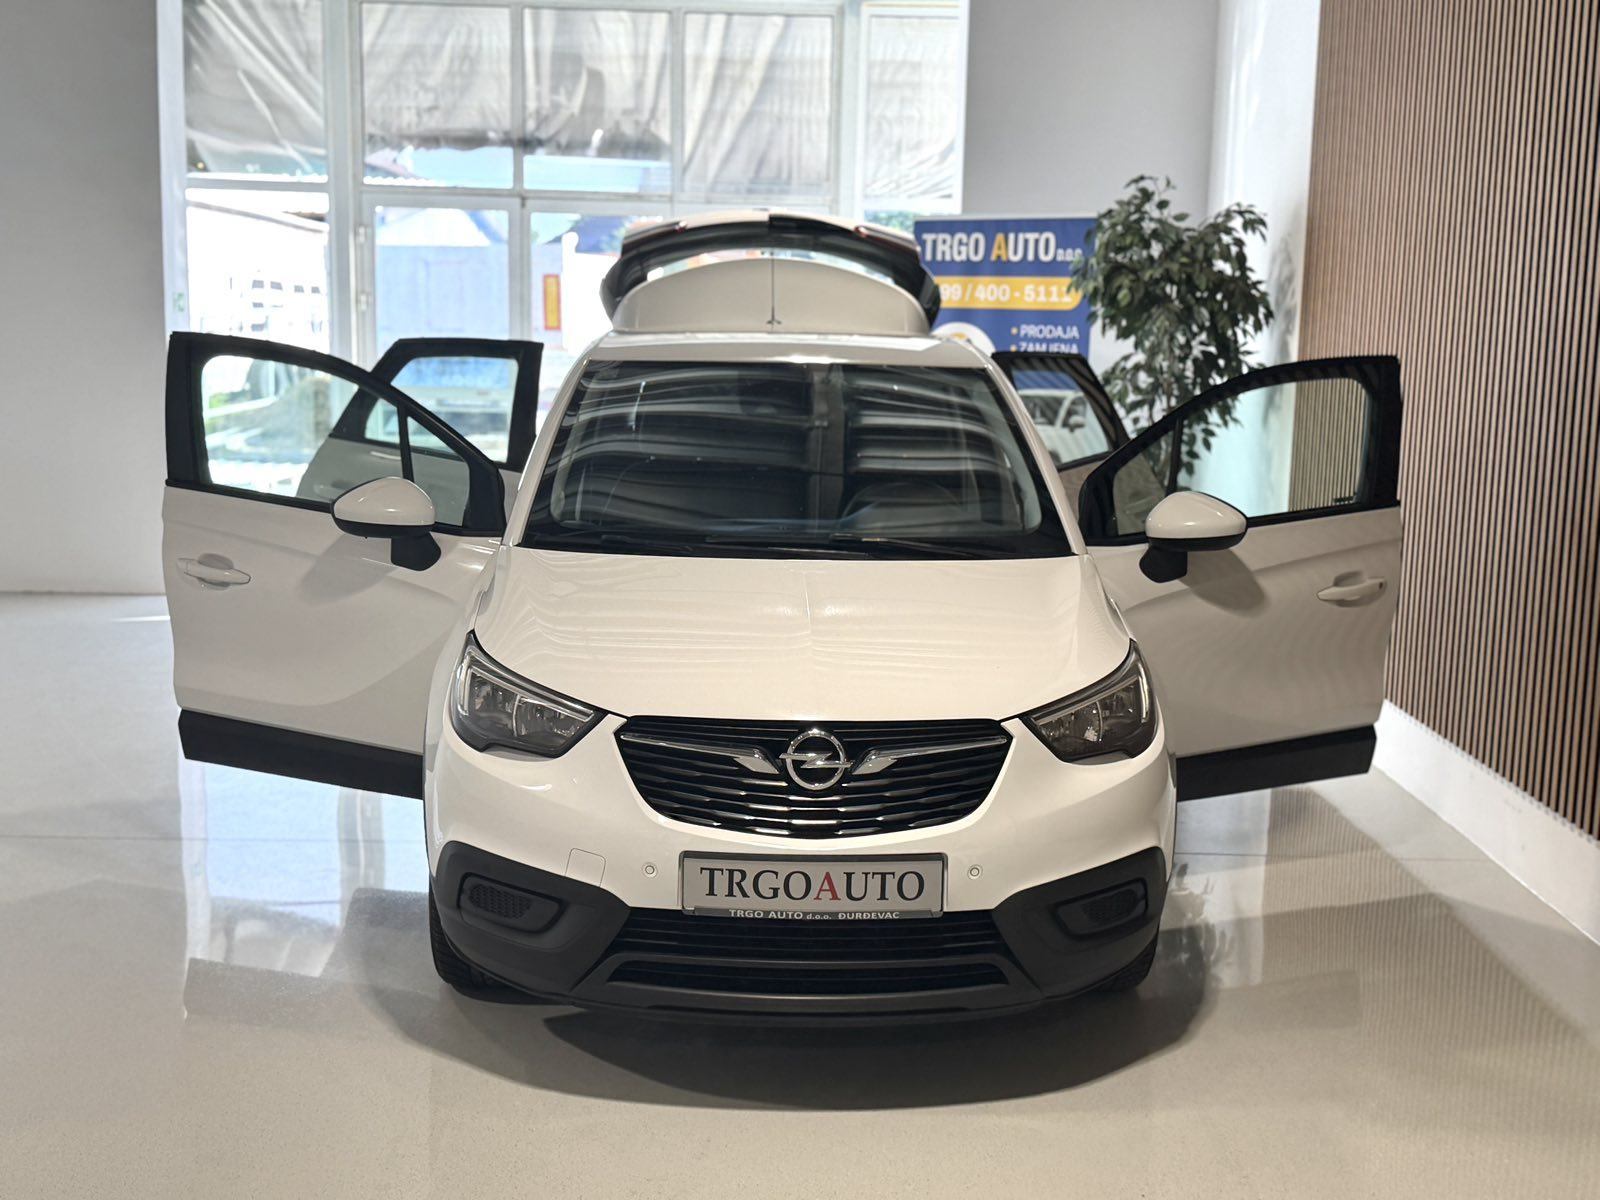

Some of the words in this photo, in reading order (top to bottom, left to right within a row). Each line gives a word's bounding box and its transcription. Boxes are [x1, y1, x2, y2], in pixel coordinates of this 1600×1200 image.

[921, 232, 986, 262] TRGO
[990, 231, 1056, 263] AUTO
[1020, 324, 1080, 339] PRODAJA
[700, 866, 925, 901] TRGOAUTO
[728, 908, 764, 919] TRGO
[768, 910, 803, 920] AUTO
[806, 911, 832, 920] d.o.o.
[838, 910, 901, 920] ĐURĐEVAC
